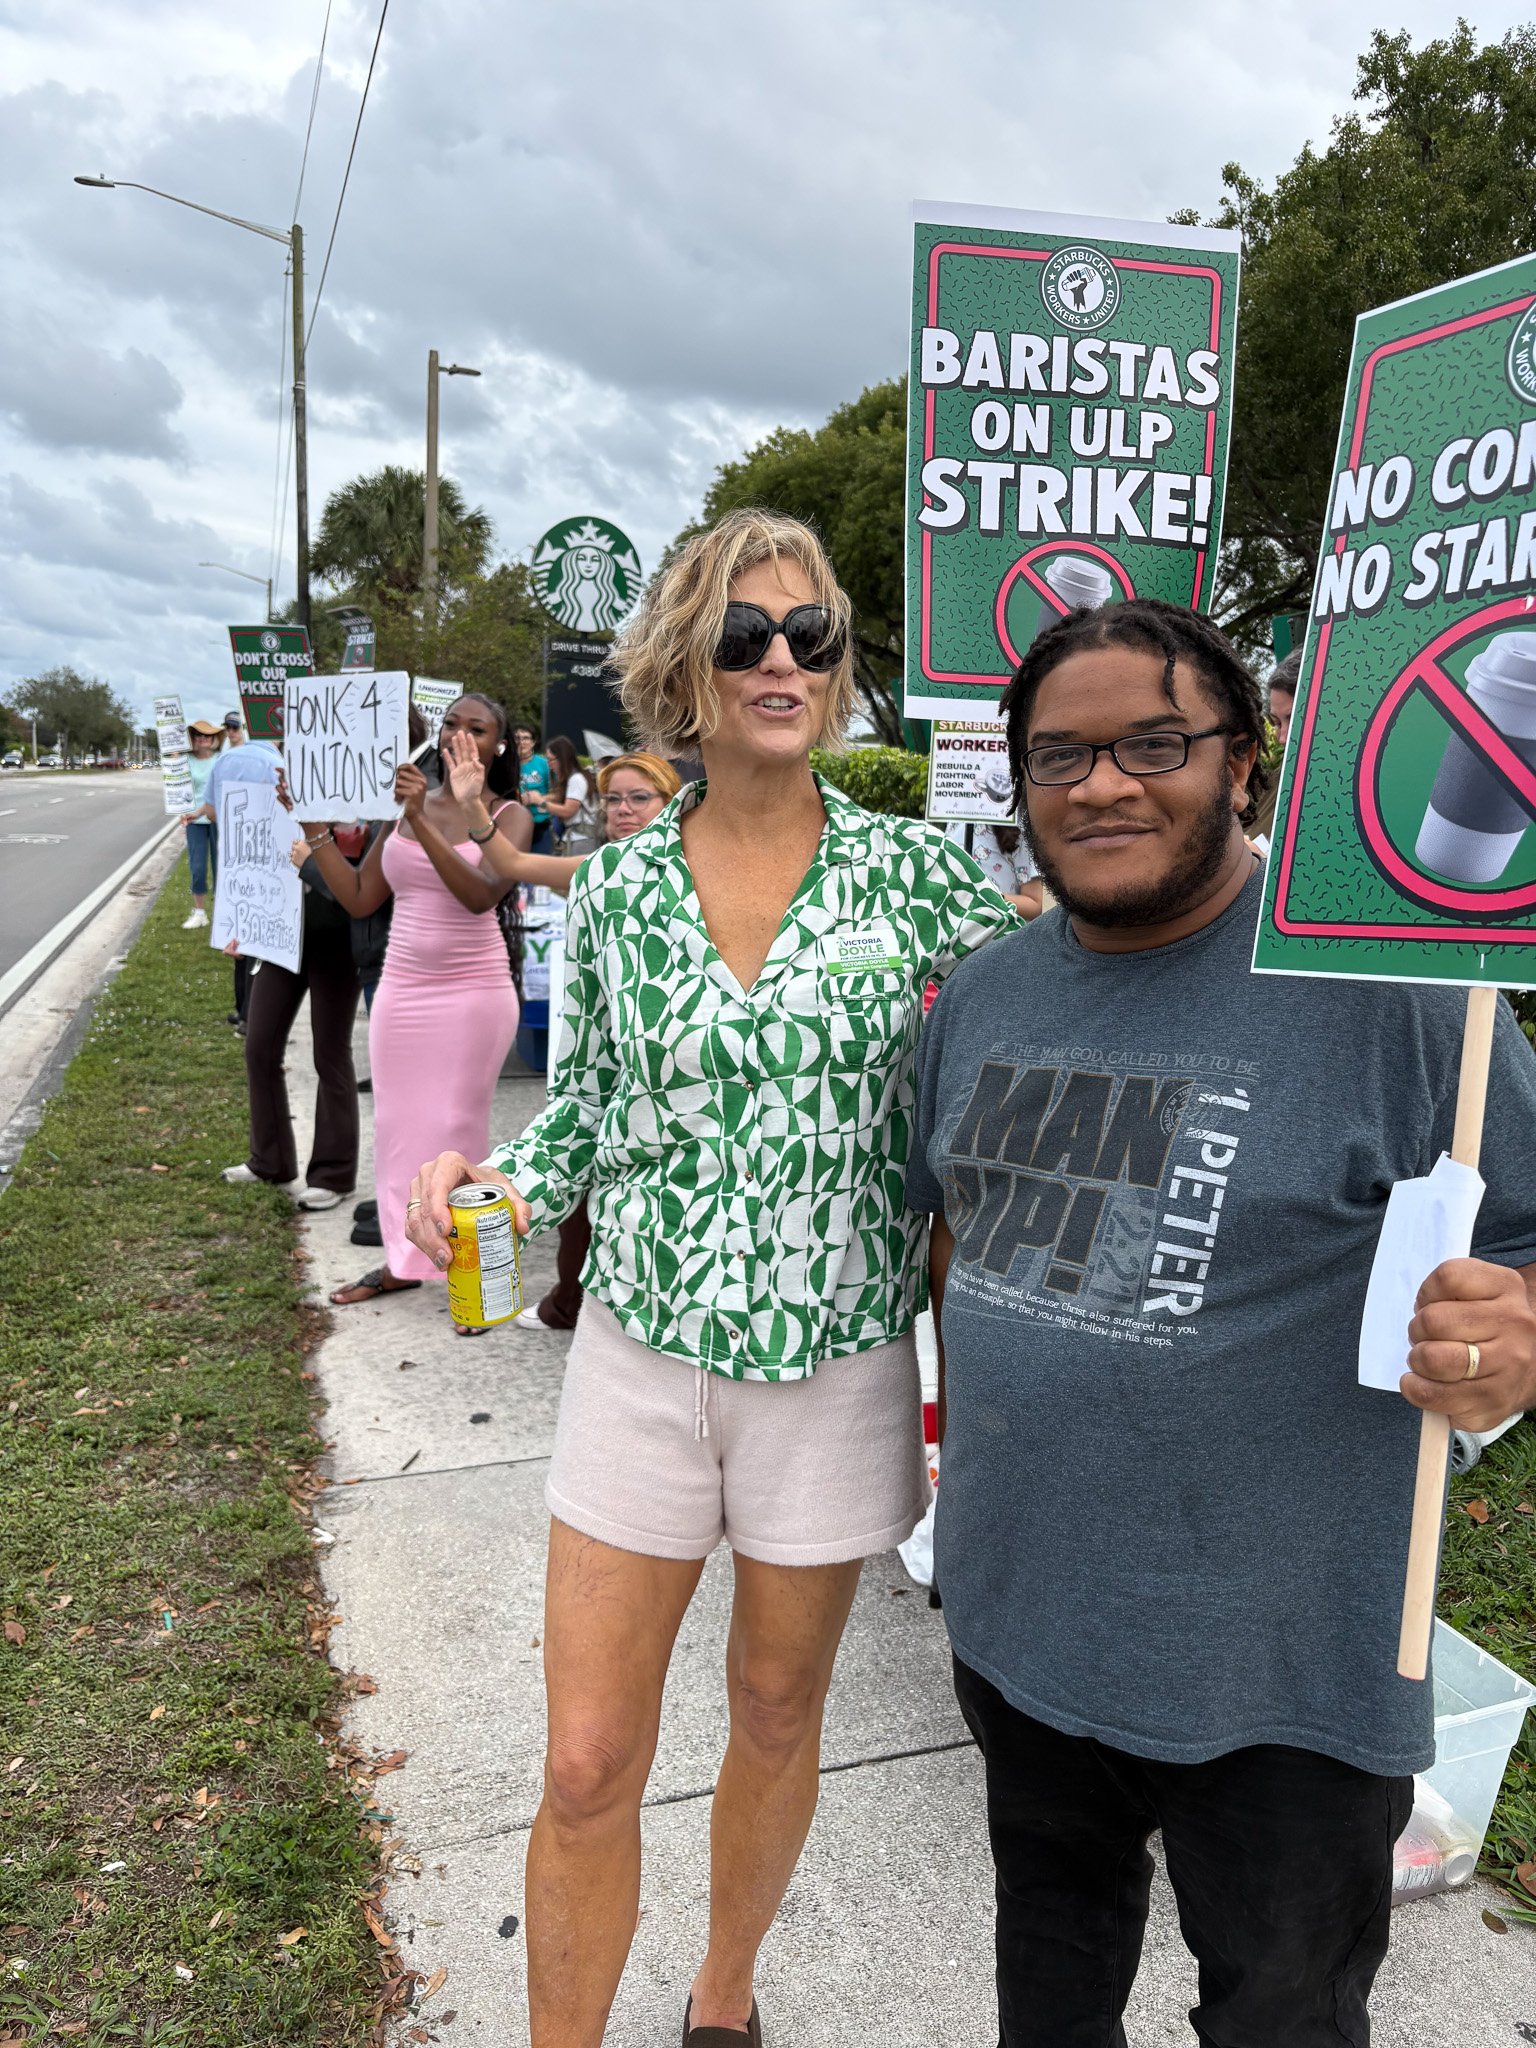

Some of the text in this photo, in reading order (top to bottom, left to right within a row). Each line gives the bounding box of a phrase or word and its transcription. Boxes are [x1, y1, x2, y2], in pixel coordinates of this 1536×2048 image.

[1053, 251, 1110, 277] STARBUCKS
[1046, 284, 1115, 325] WORKERS UNITED
[920, 327, 1221, 407] BARISTAS
[970, 400, 1174, 459] ON ULP
[917, 457, 1213, 545] STRIKE!
[1330, 455, 1414, 531] NO
[1315, 543, 1392, 617] NO
[235, 652, 312, 667] DON'T CROSS
[551, 642, 580, 653] DRIVE
[240, 681, 283, 696] PICKET
[261, 667, 287, 680] OUR
[287, 680, 382, 738] HONK 4
[936, 781, 964, 789] LABOR
[937, 763, 973, 771] REBUILD
[935, 791, 983, 799] MOVEMENT
[224, 789, 271, 868] FREE
[229, 877, 256, 897] Made
[839, 944, 886, 957] DOYLE
[843, 938, 883, 947] VICTORIA
[990, 1041, 1008, 1053] BE
[1013, 1043, 1037, 1057] THE
[1071, 1047, 1102, 1061] GOD
[1108, 1051, 1168, 1067] CALLED
[1175, 1053, 1200, 1068] YOU
[1209, 1056, 1230, 1071] TO
[1235, 1060, 1260, 1077] BE
[948, 1061, 1196, 1191] MAN
[1143, 1127, 1240, 1317] PETER
[969, 1272, 984, 1285] have
[984, 1278, 999, 1292] been
[1000, 1286, 1024, 1300] called,
[1026, 1291, 1059, 1309] because
[1061, 1302, 1086, 1318] Christ
[1089, 1310, 1111, 1322] also
[1113, 1316, 1155, 1332] suffered
[1158, 1322, 1174, 1333] for
[1177, 1325, 1199, 1336] you,
[977, 1291, 1005, 1307] example,
[1007, 1302, 1017, 1310] so
[1019, 1303, 1035, 1317] that
[1036, 1310, 1053, 1321] you
[1055, 1314, 1078, 1329] might
[1079, 1321, 1109, 1336] follow
[1111, 1327, 1121, 1339] in
[1125, 1331, 1141, 1343] his
[1143, 1336, 1174, 1348] steps.
